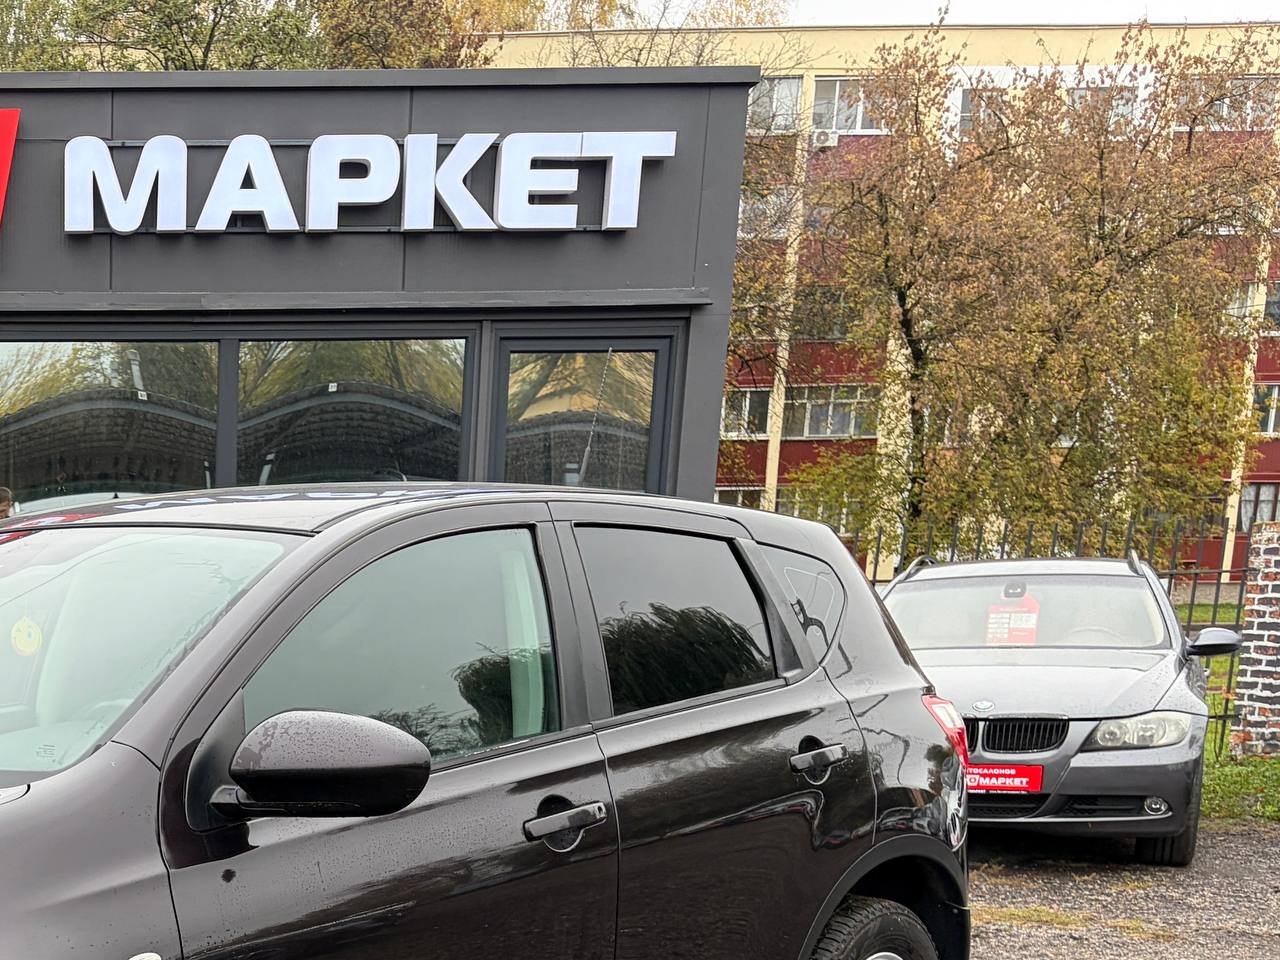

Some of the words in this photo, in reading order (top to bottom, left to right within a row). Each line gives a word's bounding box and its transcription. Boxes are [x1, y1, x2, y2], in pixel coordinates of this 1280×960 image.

[63, 130, 677, 236] МАРКЕТ
[967, 767, 1016, 775] ТОСАЛОНОВ
[979, 777, 1029, 786] МАРКЕТ
